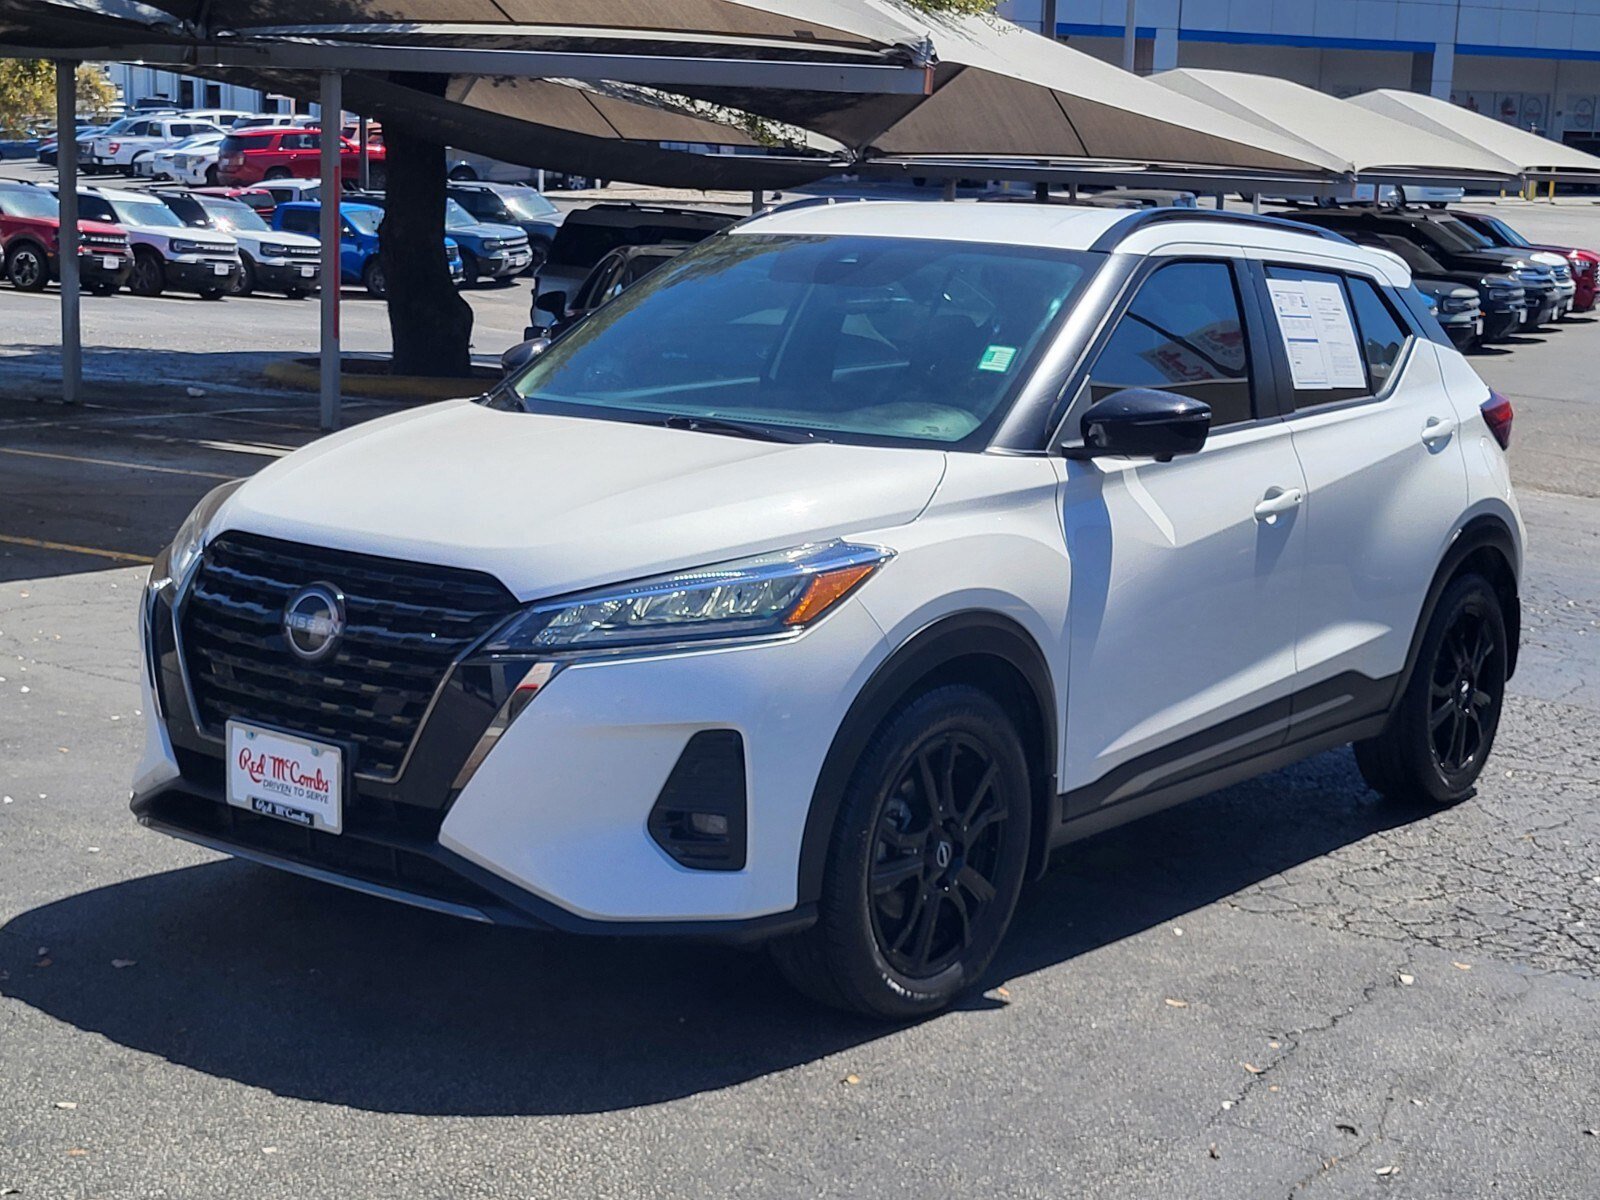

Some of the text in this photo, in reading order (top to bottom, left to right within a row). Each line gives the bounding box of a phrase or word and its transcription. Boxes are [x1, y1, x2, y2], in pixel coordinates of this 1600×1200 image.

[239, 747, 329, 793] Red McCombs
[262, 779, 329, 805] DRIVEN TO SERVE
